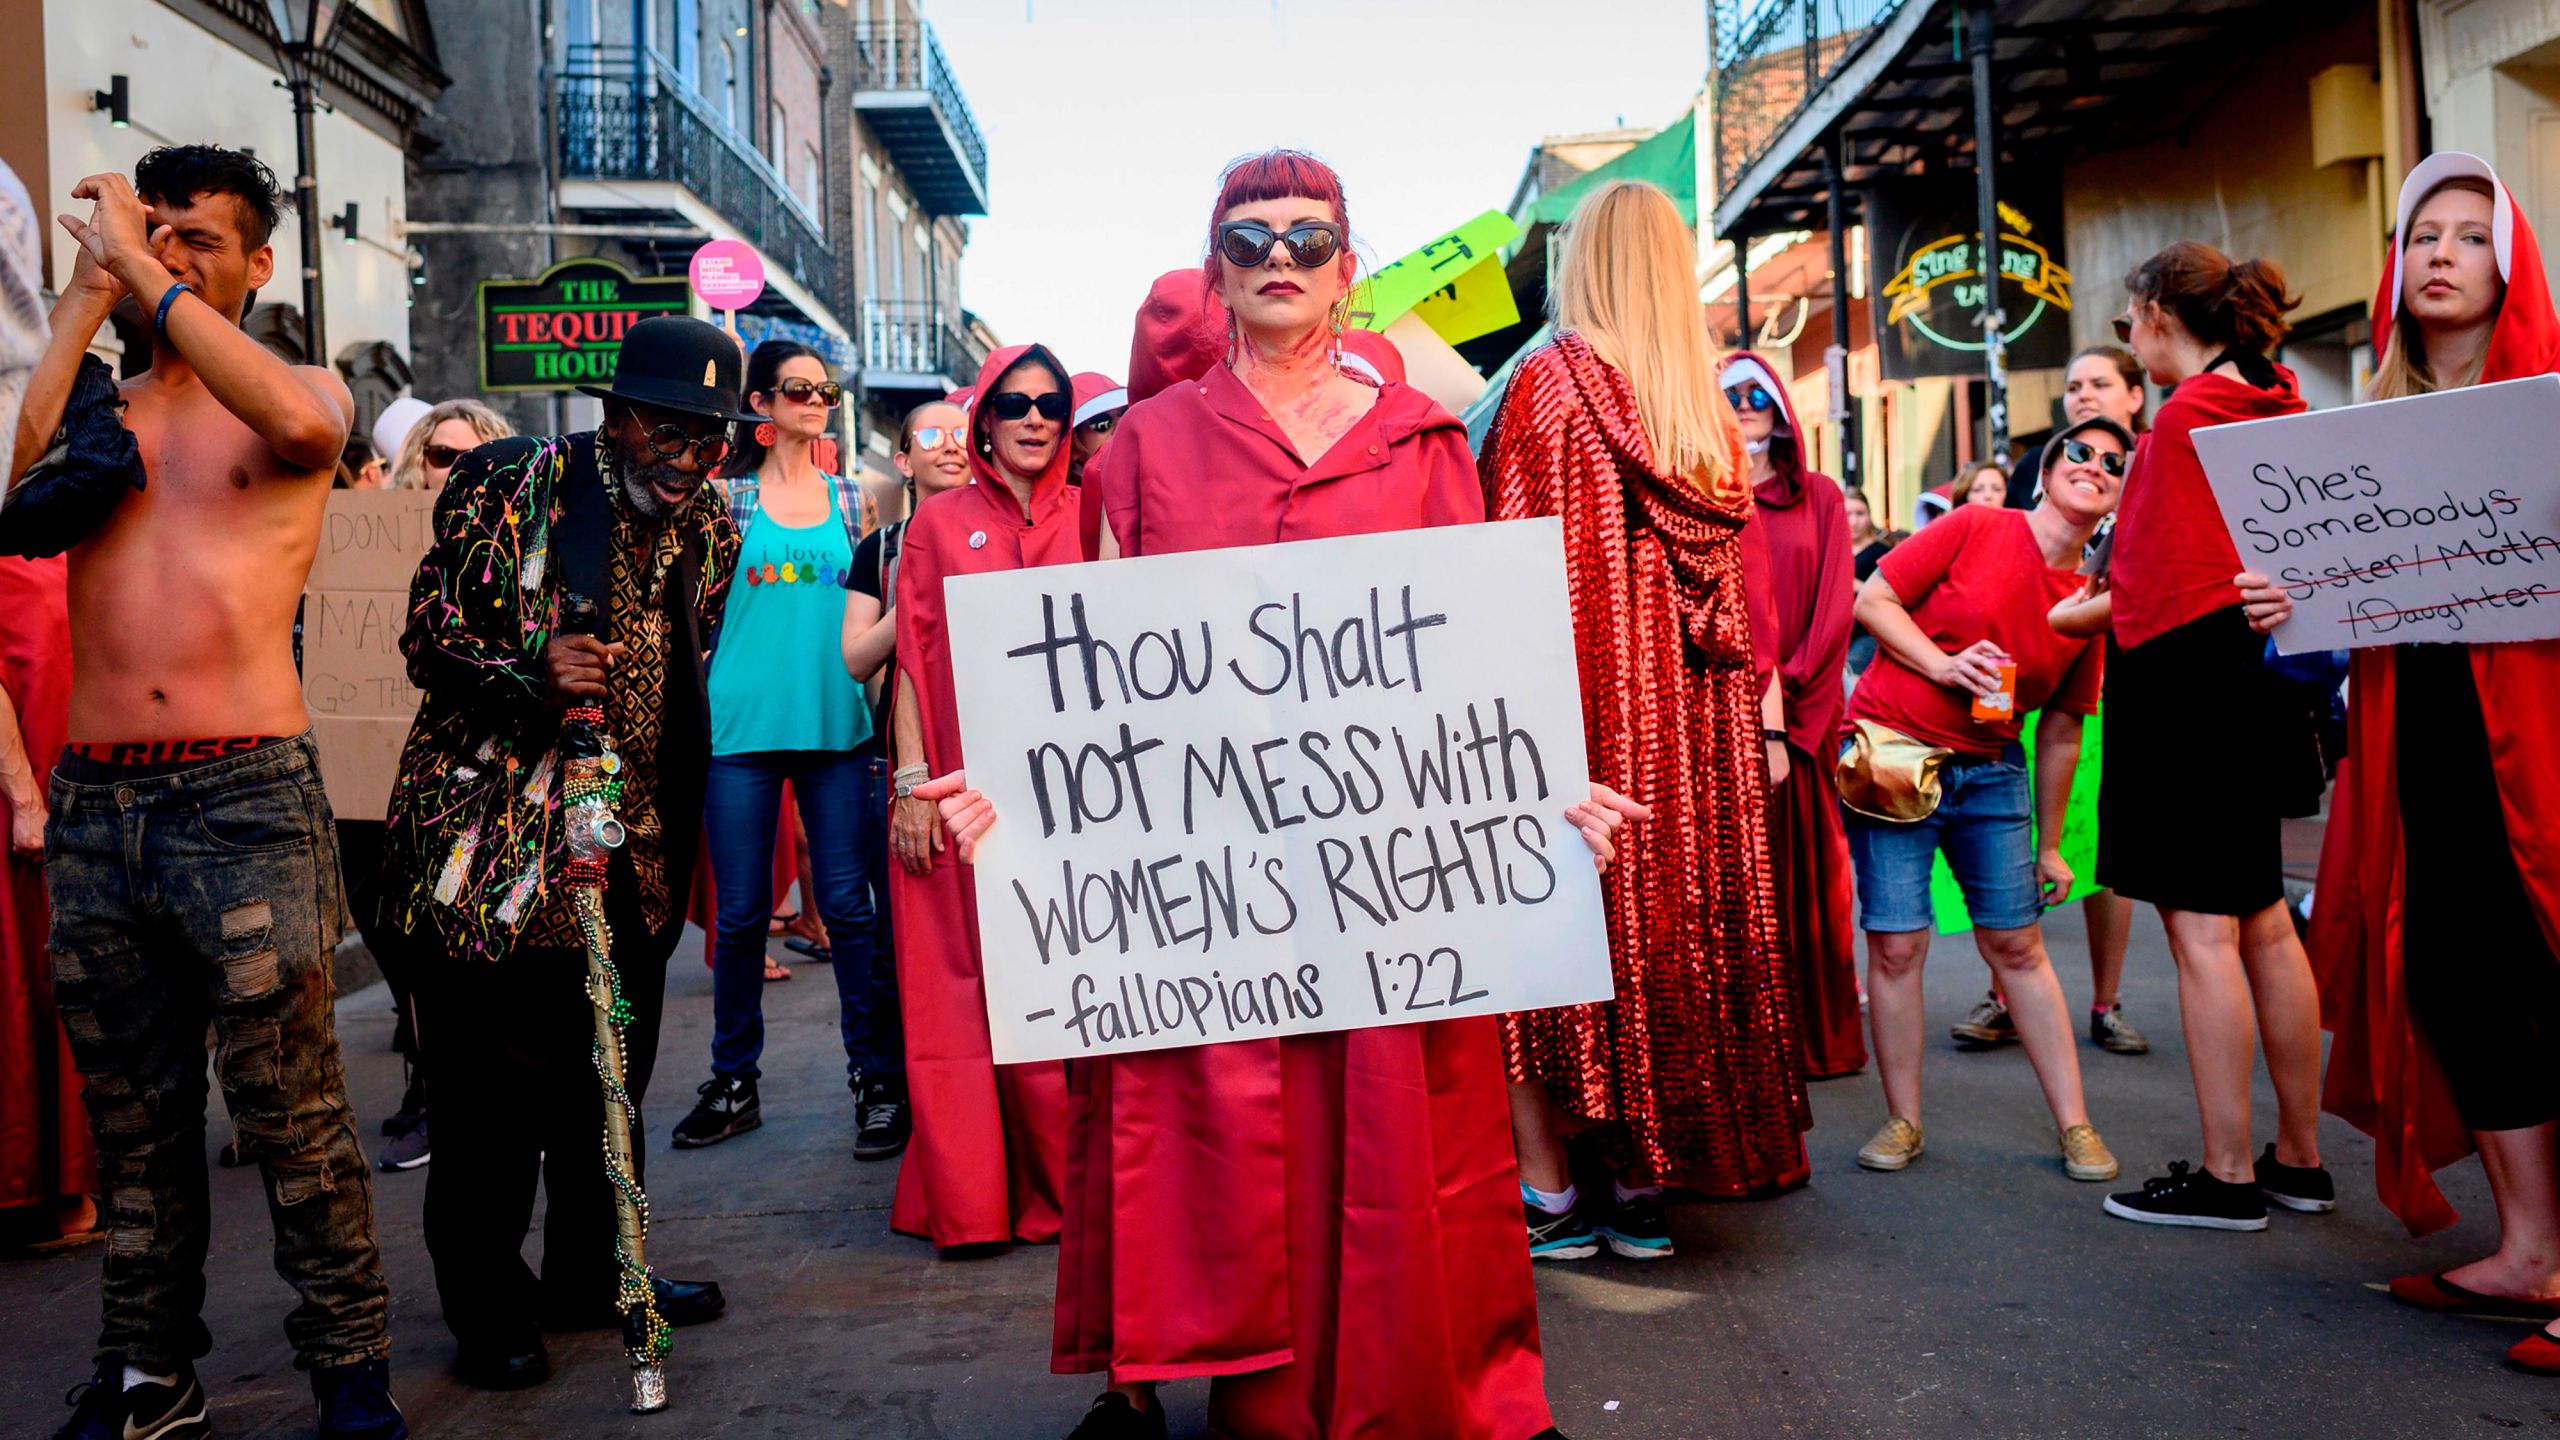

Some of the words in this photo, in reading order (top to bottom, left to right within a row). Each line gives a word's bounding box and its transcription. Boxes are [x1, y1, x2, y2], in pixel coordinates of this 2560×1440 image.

[558, 279, 619, 302] THE
[497, 310, 669, 348] TEQUI
[534, 351, 619, 380] HOUS
[2252, 463, 2382, 514] She's
[329, 504, 433, 554] DON'T
[2242, 489, 2522, 555] Somebodys
[762, 544, 767, 562] i
[785, 543, 834, 563] love
[1006, 592, 1213, 713] thou
[1027, 722, 1165, 839] not
[1183, 724, 1384, 835] MESS
[1012, 845, 1298, 965] WOMEN'S
[1316, 814, 1556, 933] RIGHTS
[1365, 947, 1489, 1016] 1:22
